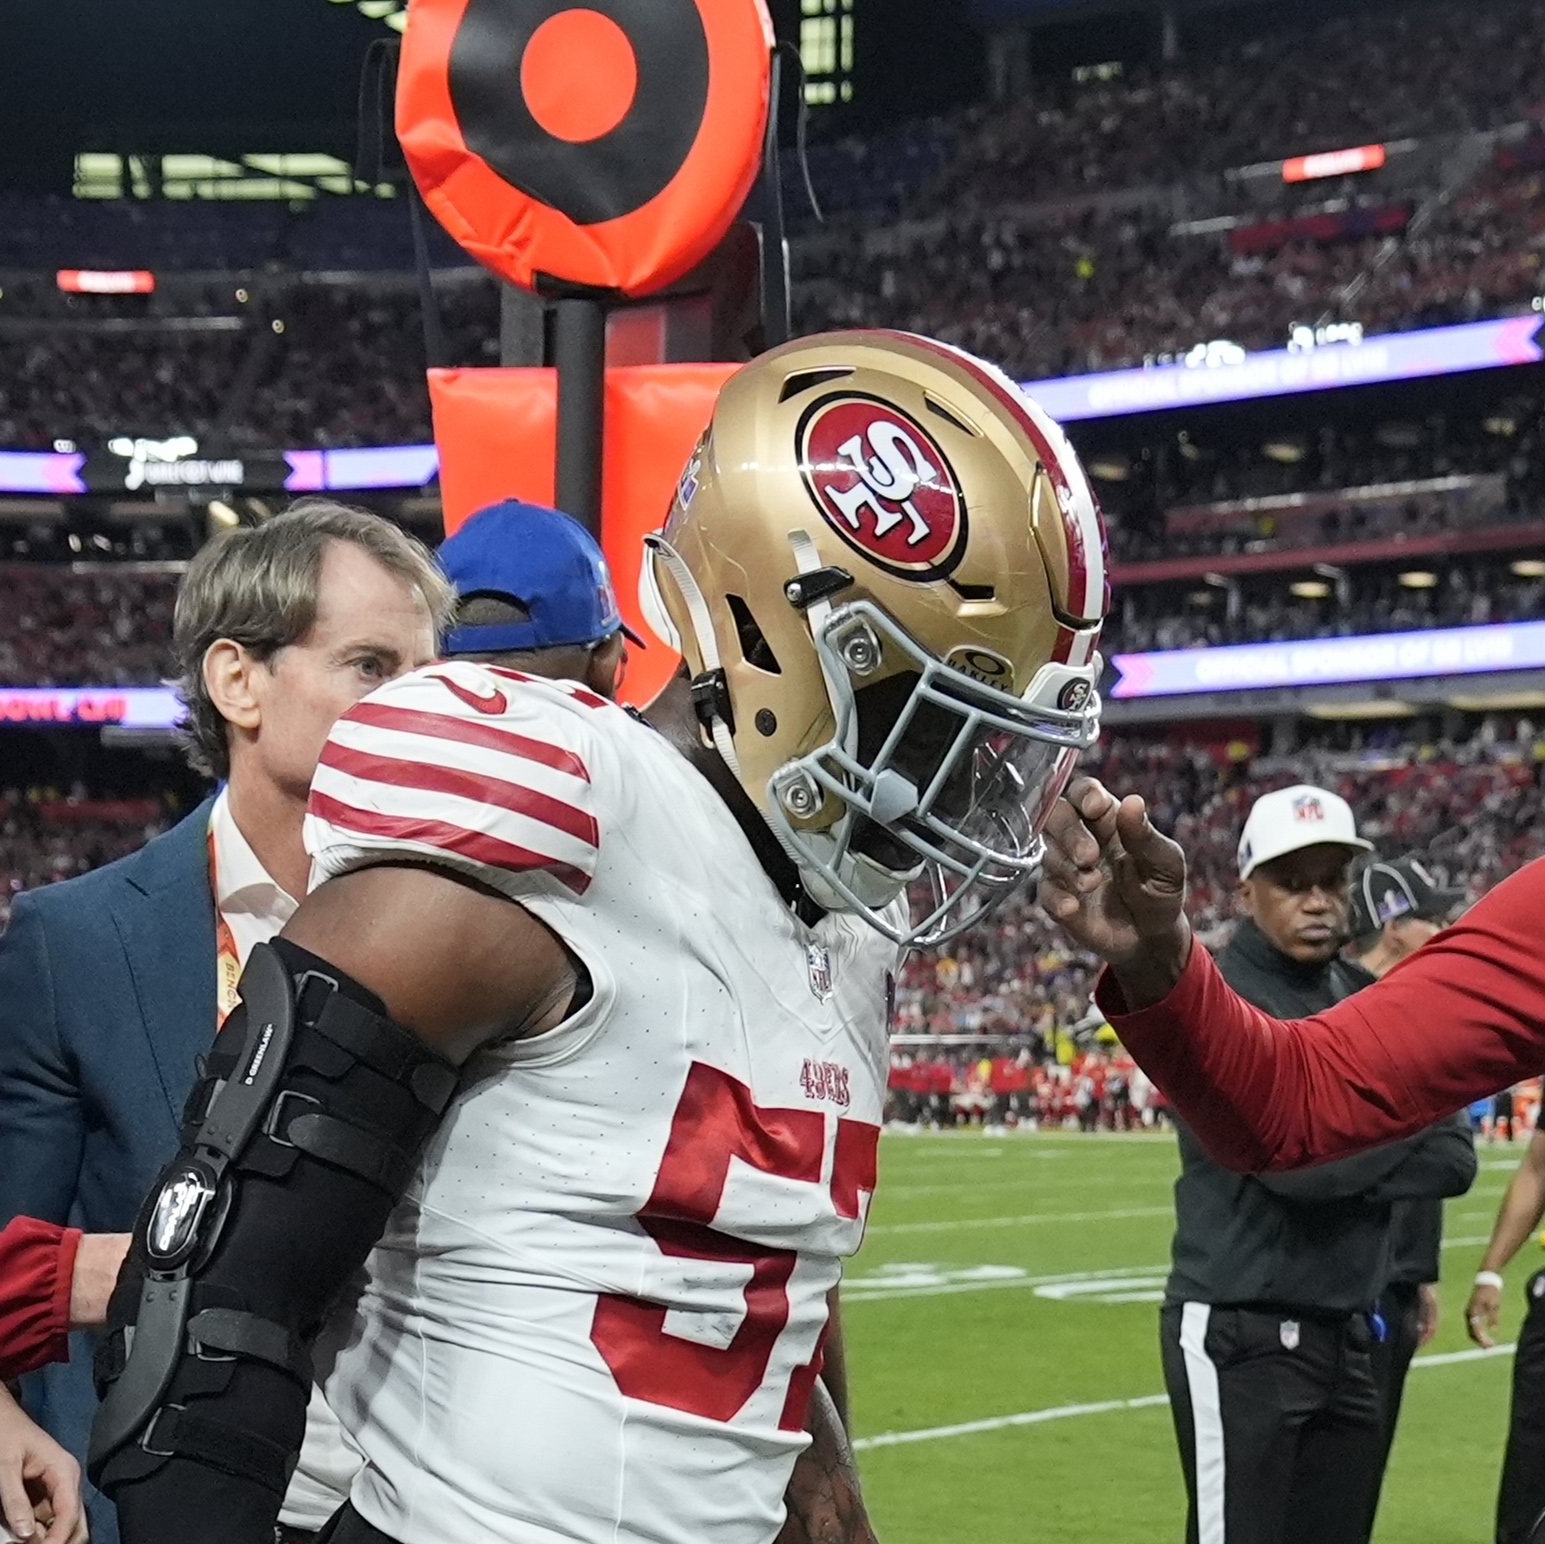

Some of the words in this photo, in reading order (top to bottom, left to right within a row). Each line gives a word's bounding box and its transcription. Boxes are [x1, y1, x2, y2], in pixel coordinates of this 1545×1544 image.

[823, 420, 938, 546] SF
[244, 1074, 255, 1086] D
[799, 1058, 850, 1108] 49ERS
